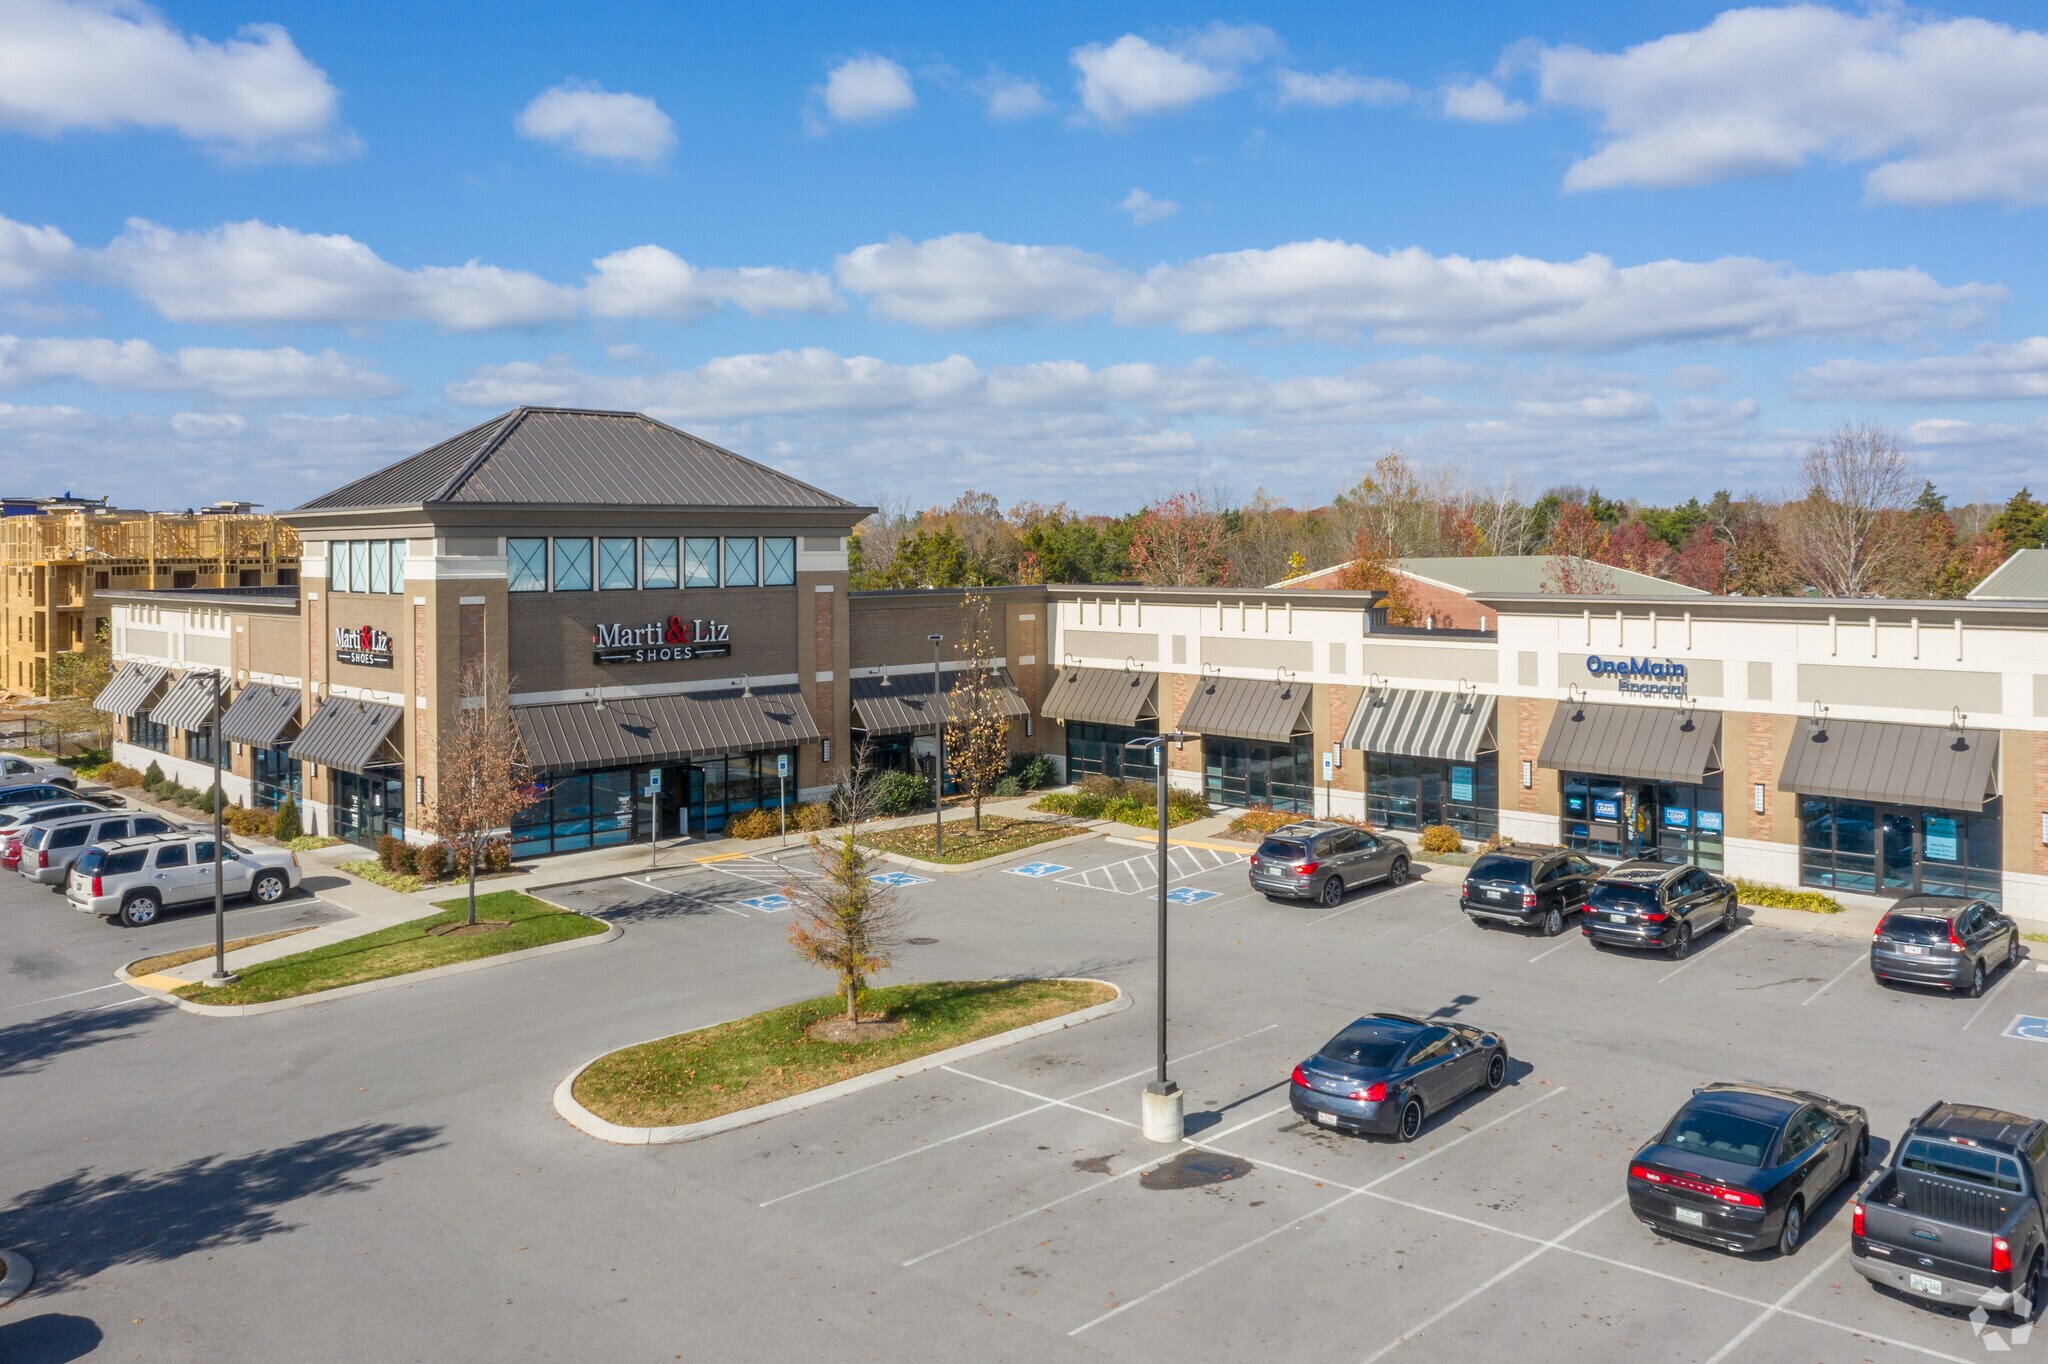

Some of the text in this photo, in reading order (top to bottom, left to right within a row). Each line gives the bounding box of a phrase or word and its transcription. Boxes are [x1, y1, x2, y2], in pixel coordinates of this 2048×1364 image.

[335, 627, 361, 649] Marti
[371, 630, 387, 651] Liz
[595, 622, 664, 648] Marti
[693, 619, 729, 643] Liz
[350, 652, 374, 664] SHOES
[636, 646, 692, 662] SHOES
[1586, 655, 1685, 677] OneMain
[1618, 678, 1684, 696] Financial
[1596, 805, 1616, 813] LOANS
